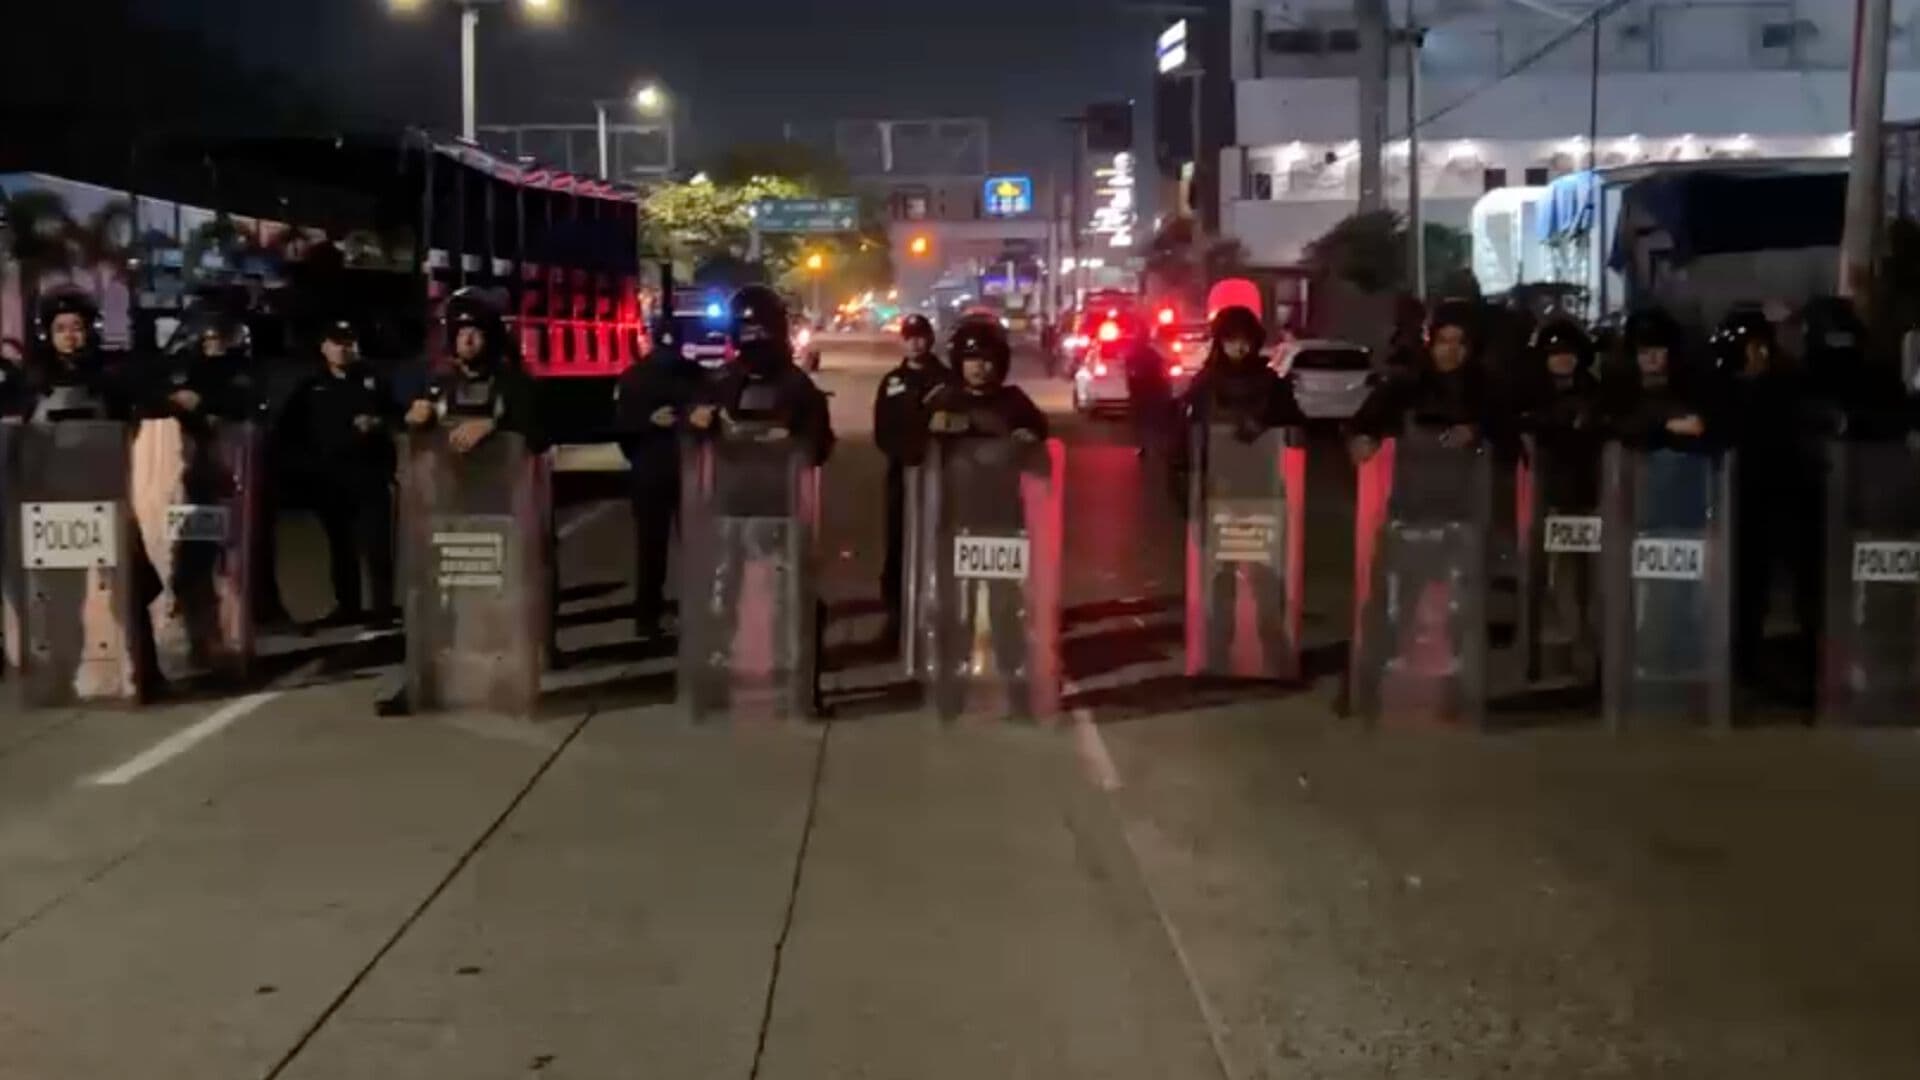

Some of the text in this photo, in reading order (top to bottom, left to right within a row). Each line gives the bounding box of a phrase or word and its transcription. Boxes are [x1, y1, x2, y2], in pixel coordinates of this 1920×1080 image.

[33, 521, 102, 550] POLICIA
[1551, 522, 1598, 545] POLICI
[959, 545, 1022, 572] POLICIA
[1637, 545, 1697, 571] POLICIA
